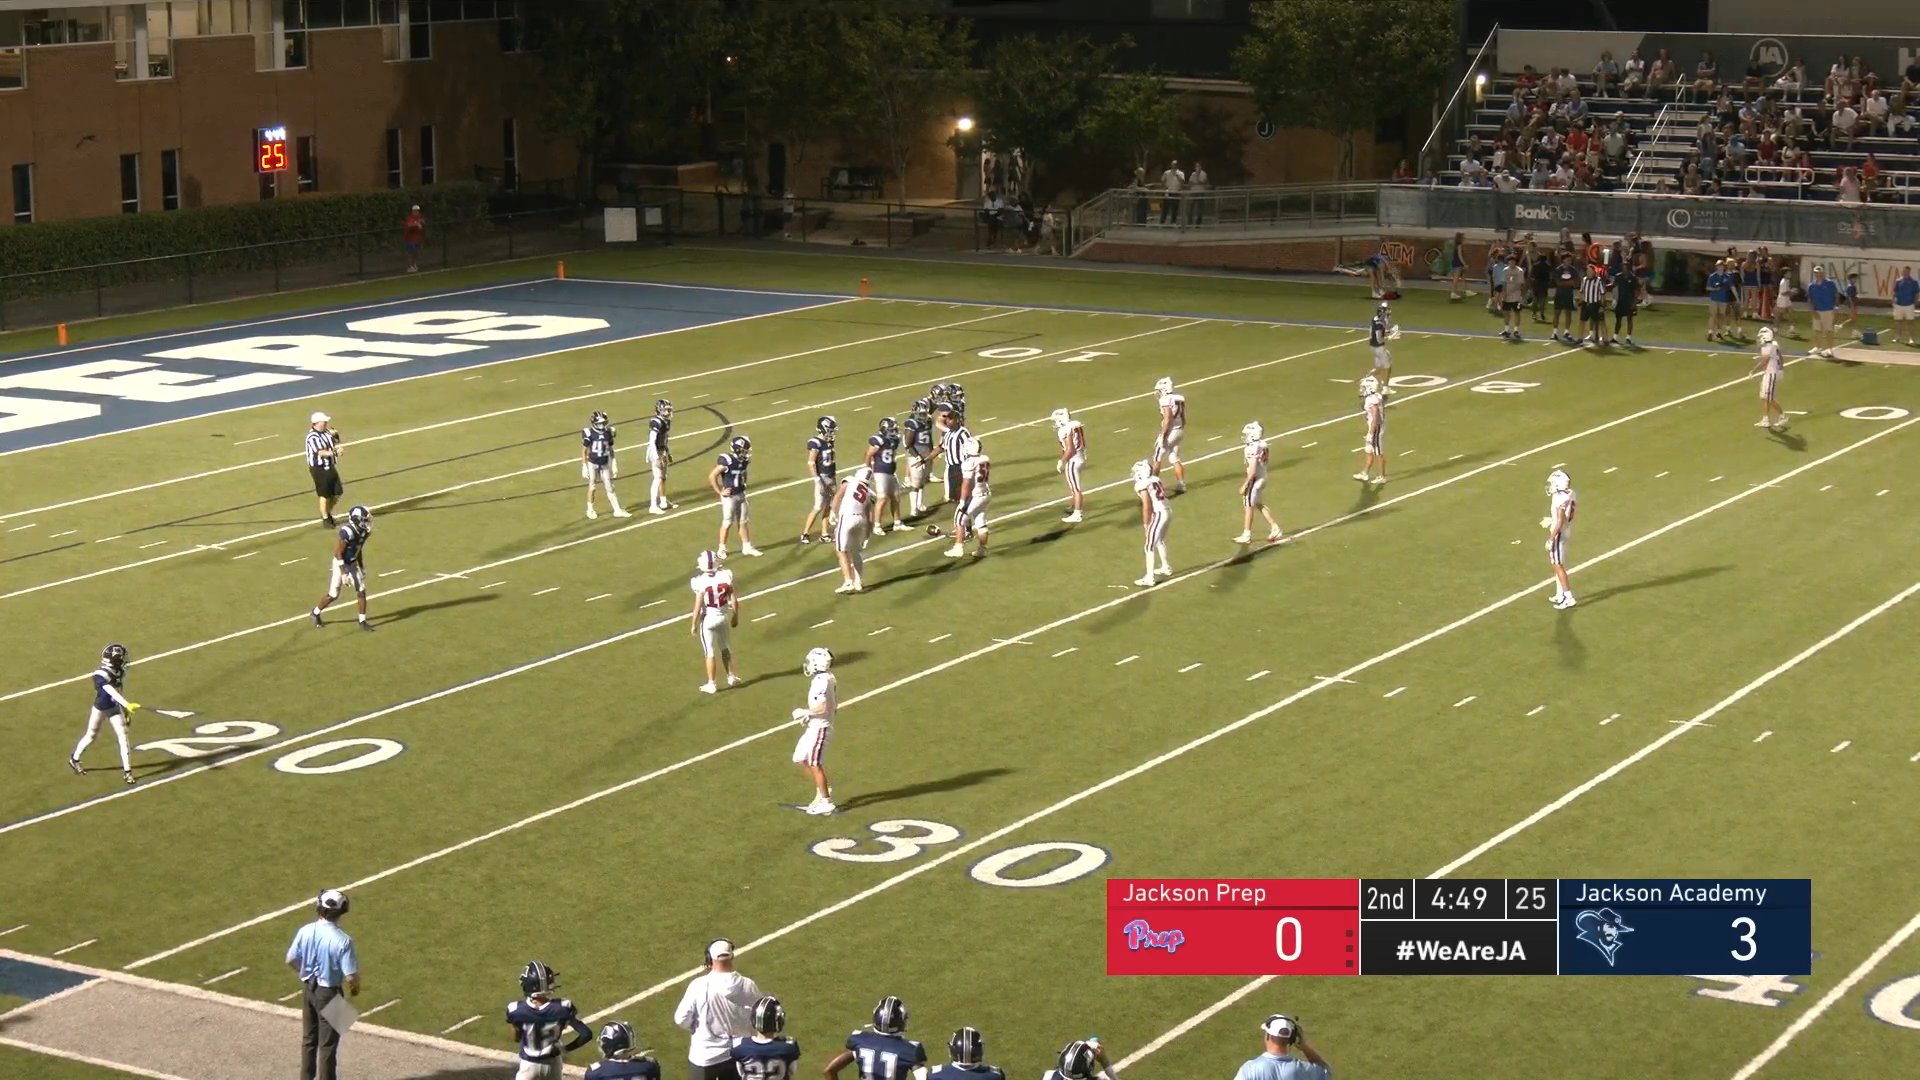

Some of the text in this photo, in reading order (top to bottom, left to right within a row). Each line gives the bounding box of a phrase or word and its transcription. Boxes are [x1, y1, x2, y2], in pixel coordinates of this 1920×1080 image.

[261, 143, 284, 169] 25
[1515, 204, 1575, 222] BankPlus
[704, 583, 732, 608] 12
[859, 1047, 898, 1080] 11
